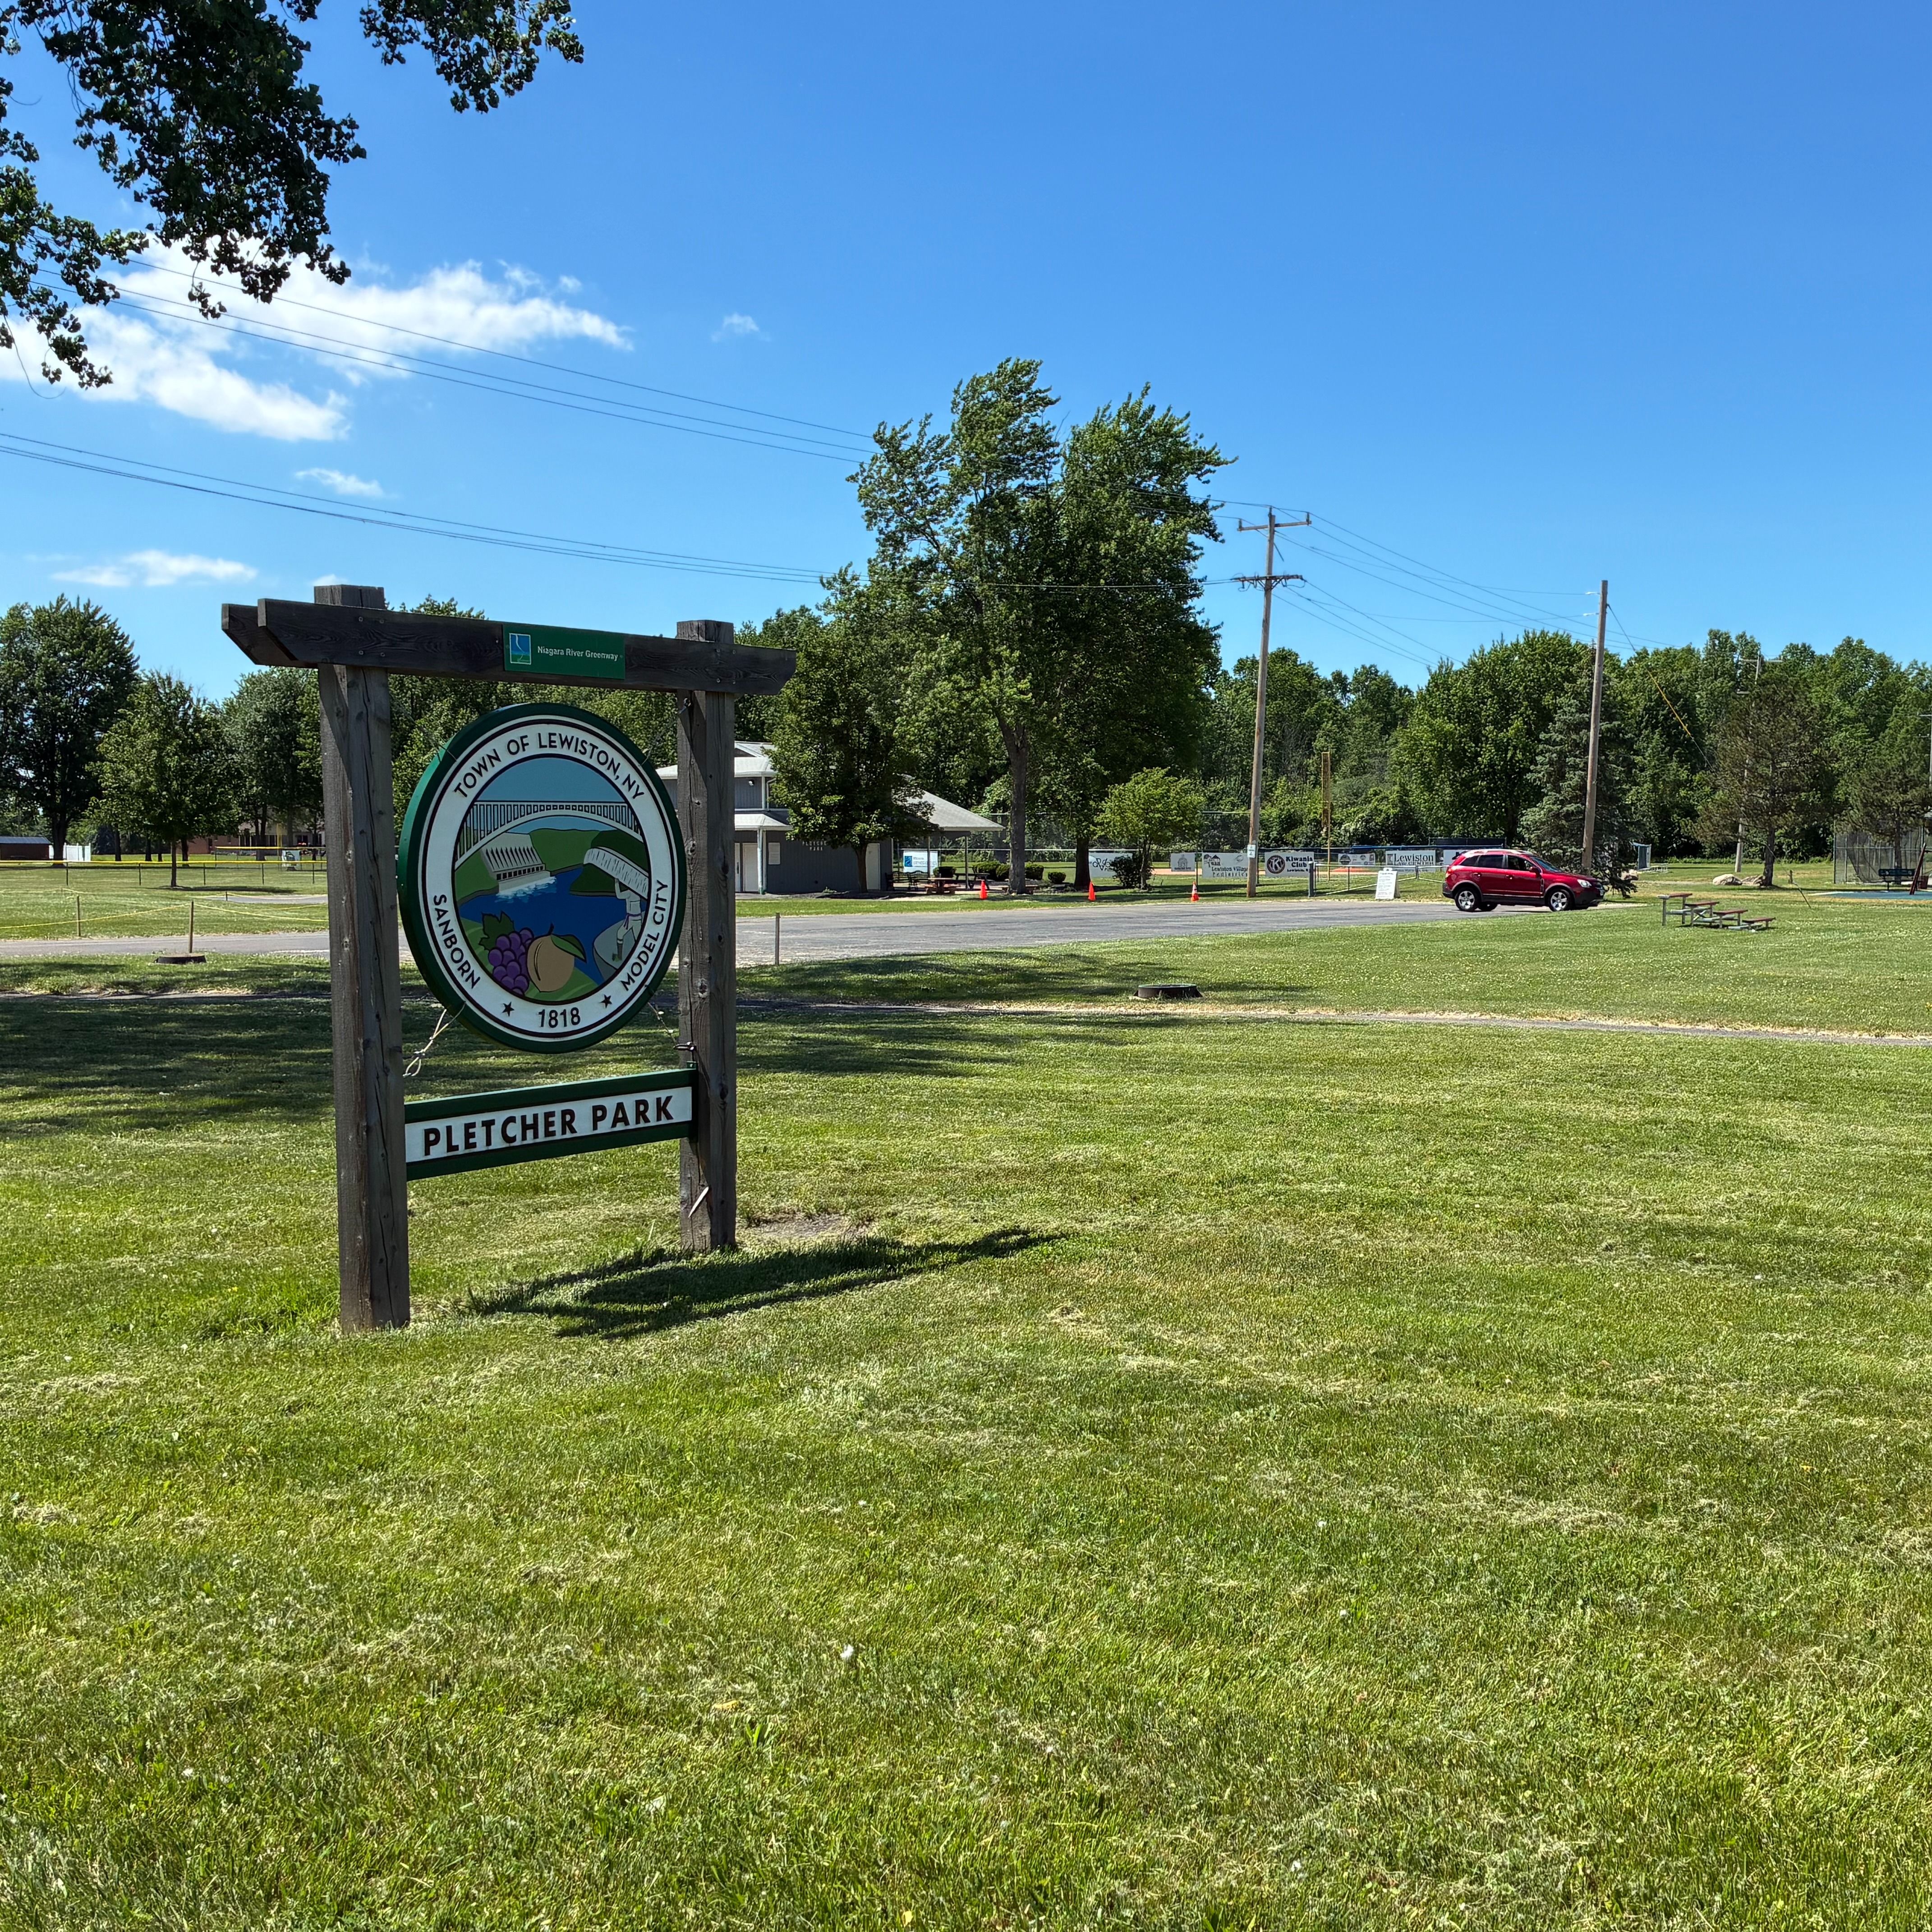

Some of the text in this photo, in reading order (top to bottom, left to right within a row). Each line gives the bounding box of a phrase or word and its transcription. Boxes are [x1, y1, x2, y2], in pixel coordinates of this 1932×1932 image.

[538, 646, 618, 661] Niagara River Greenway
[454, 732, 645, 800] TOWN OF LEWISTON, NY
[1394, 854, 1434, 862] Lewiston
[433, 894, 480, 989] SANBORN
[621, 880, 668, 991] MODEL CITY
[538, 1007, 581, 1028] 1818
[424, 1095, 674, 1156] PLETCHER PARK
